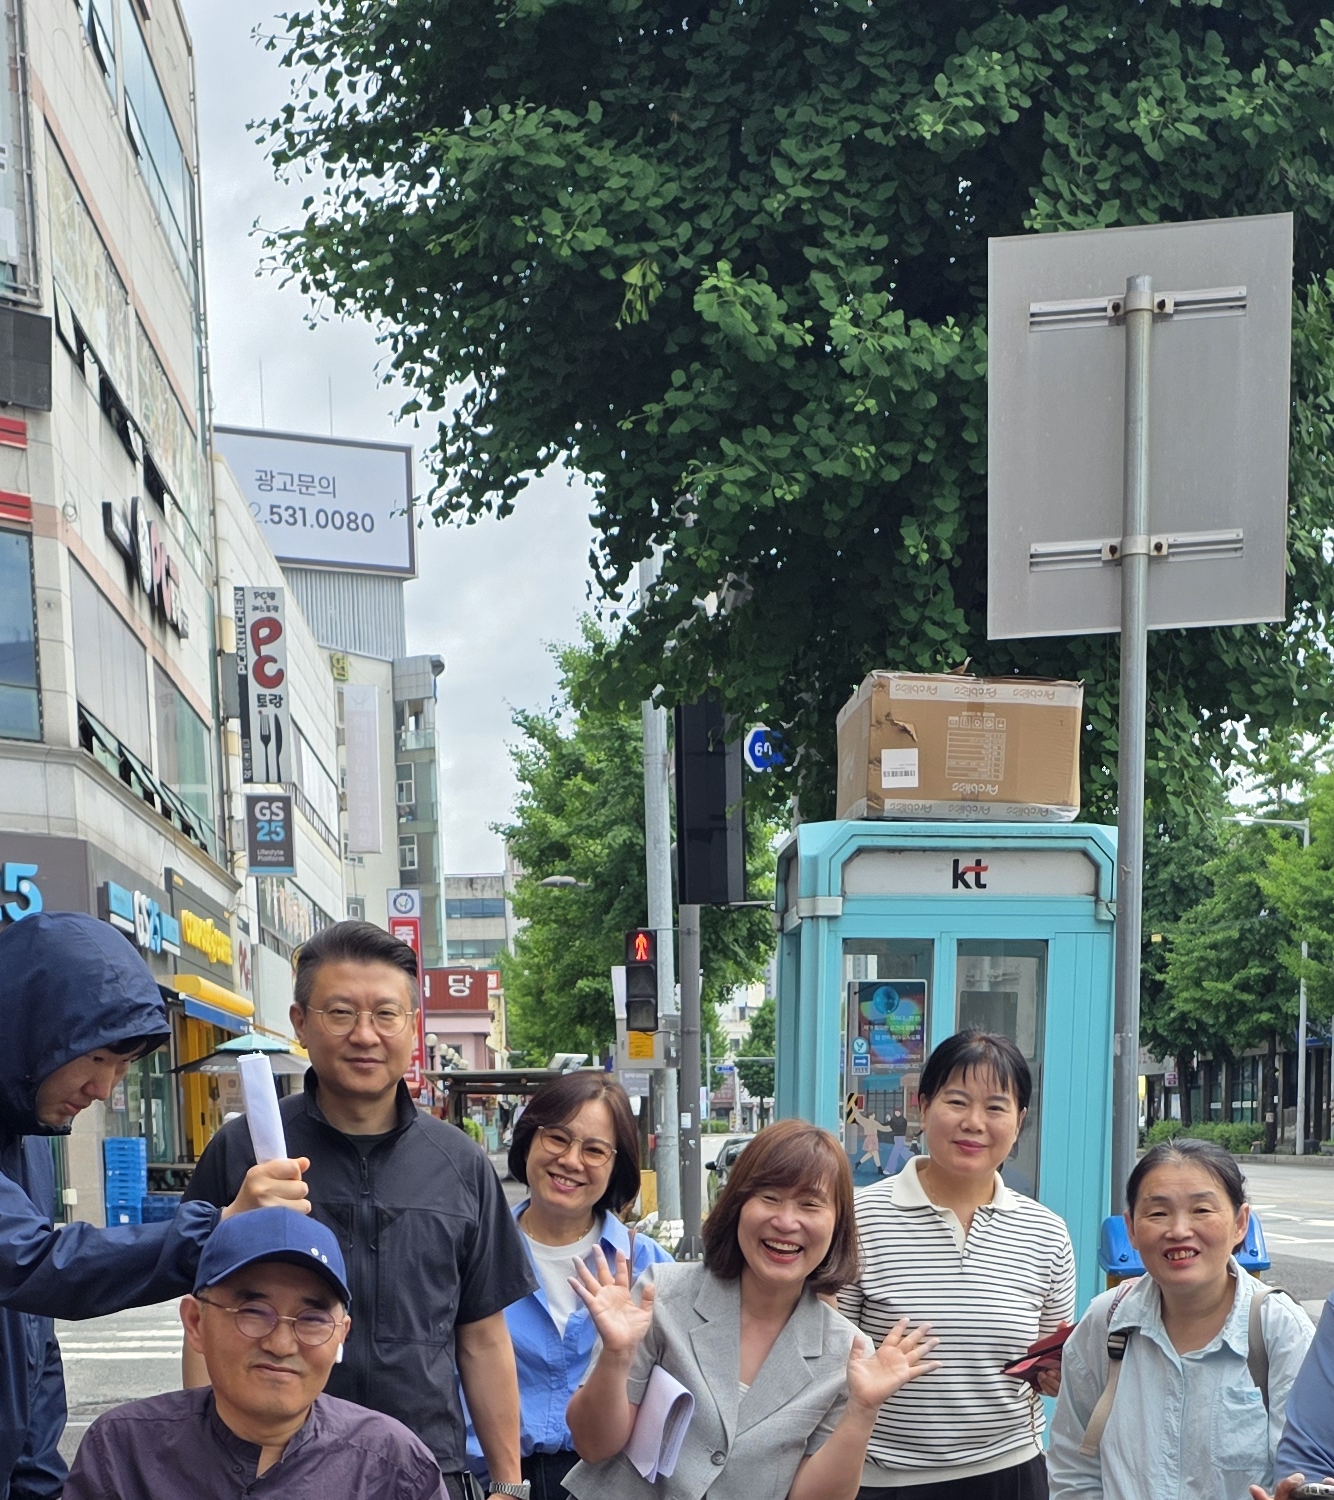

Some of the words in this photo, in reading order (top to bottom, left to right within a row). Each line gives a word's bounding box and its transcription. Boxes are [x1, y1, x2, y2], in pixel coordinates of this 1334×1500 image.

[254, 467, 338, 500] 광고문의
[235, 589, 248, 675] PC&KITCHEN
[250, 617, 284, 689] PC
[256, 693, 284, 709] 토랑
[951, 781, 999, 796] Arcbliss
[254, 800, 285, 821] GS
[256, 821, 286, 842] 25
[951, 858, 989, 890] kt
[134, 889, 162, 955] GS25
